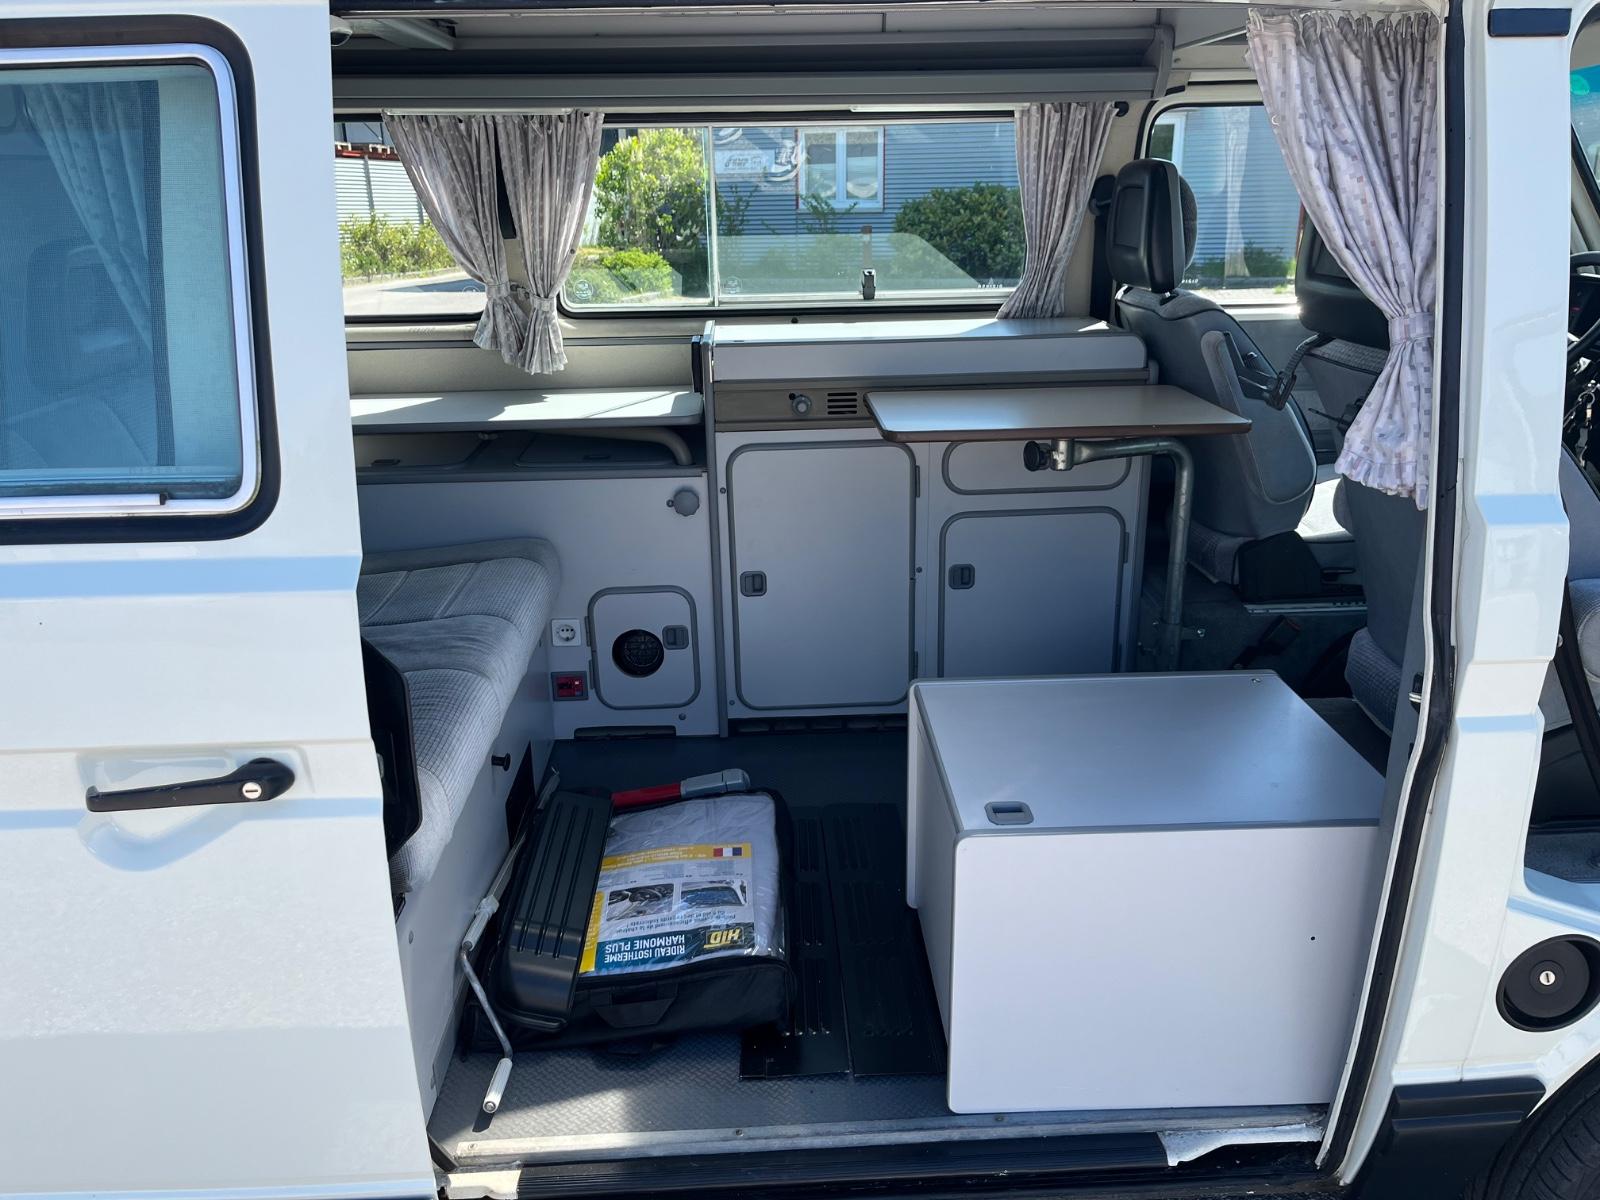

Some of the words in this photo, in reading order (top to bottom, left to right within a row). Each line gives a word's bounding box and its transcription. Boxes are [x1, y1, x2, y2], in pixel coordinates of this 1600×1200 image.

[605, 941, 631, 954] PLUS
[634, 935, 685, 949] HARMONIE
[604, 950, 652, 963] ISOTHERME
[654, 945, 685, 957] RIDEAU
